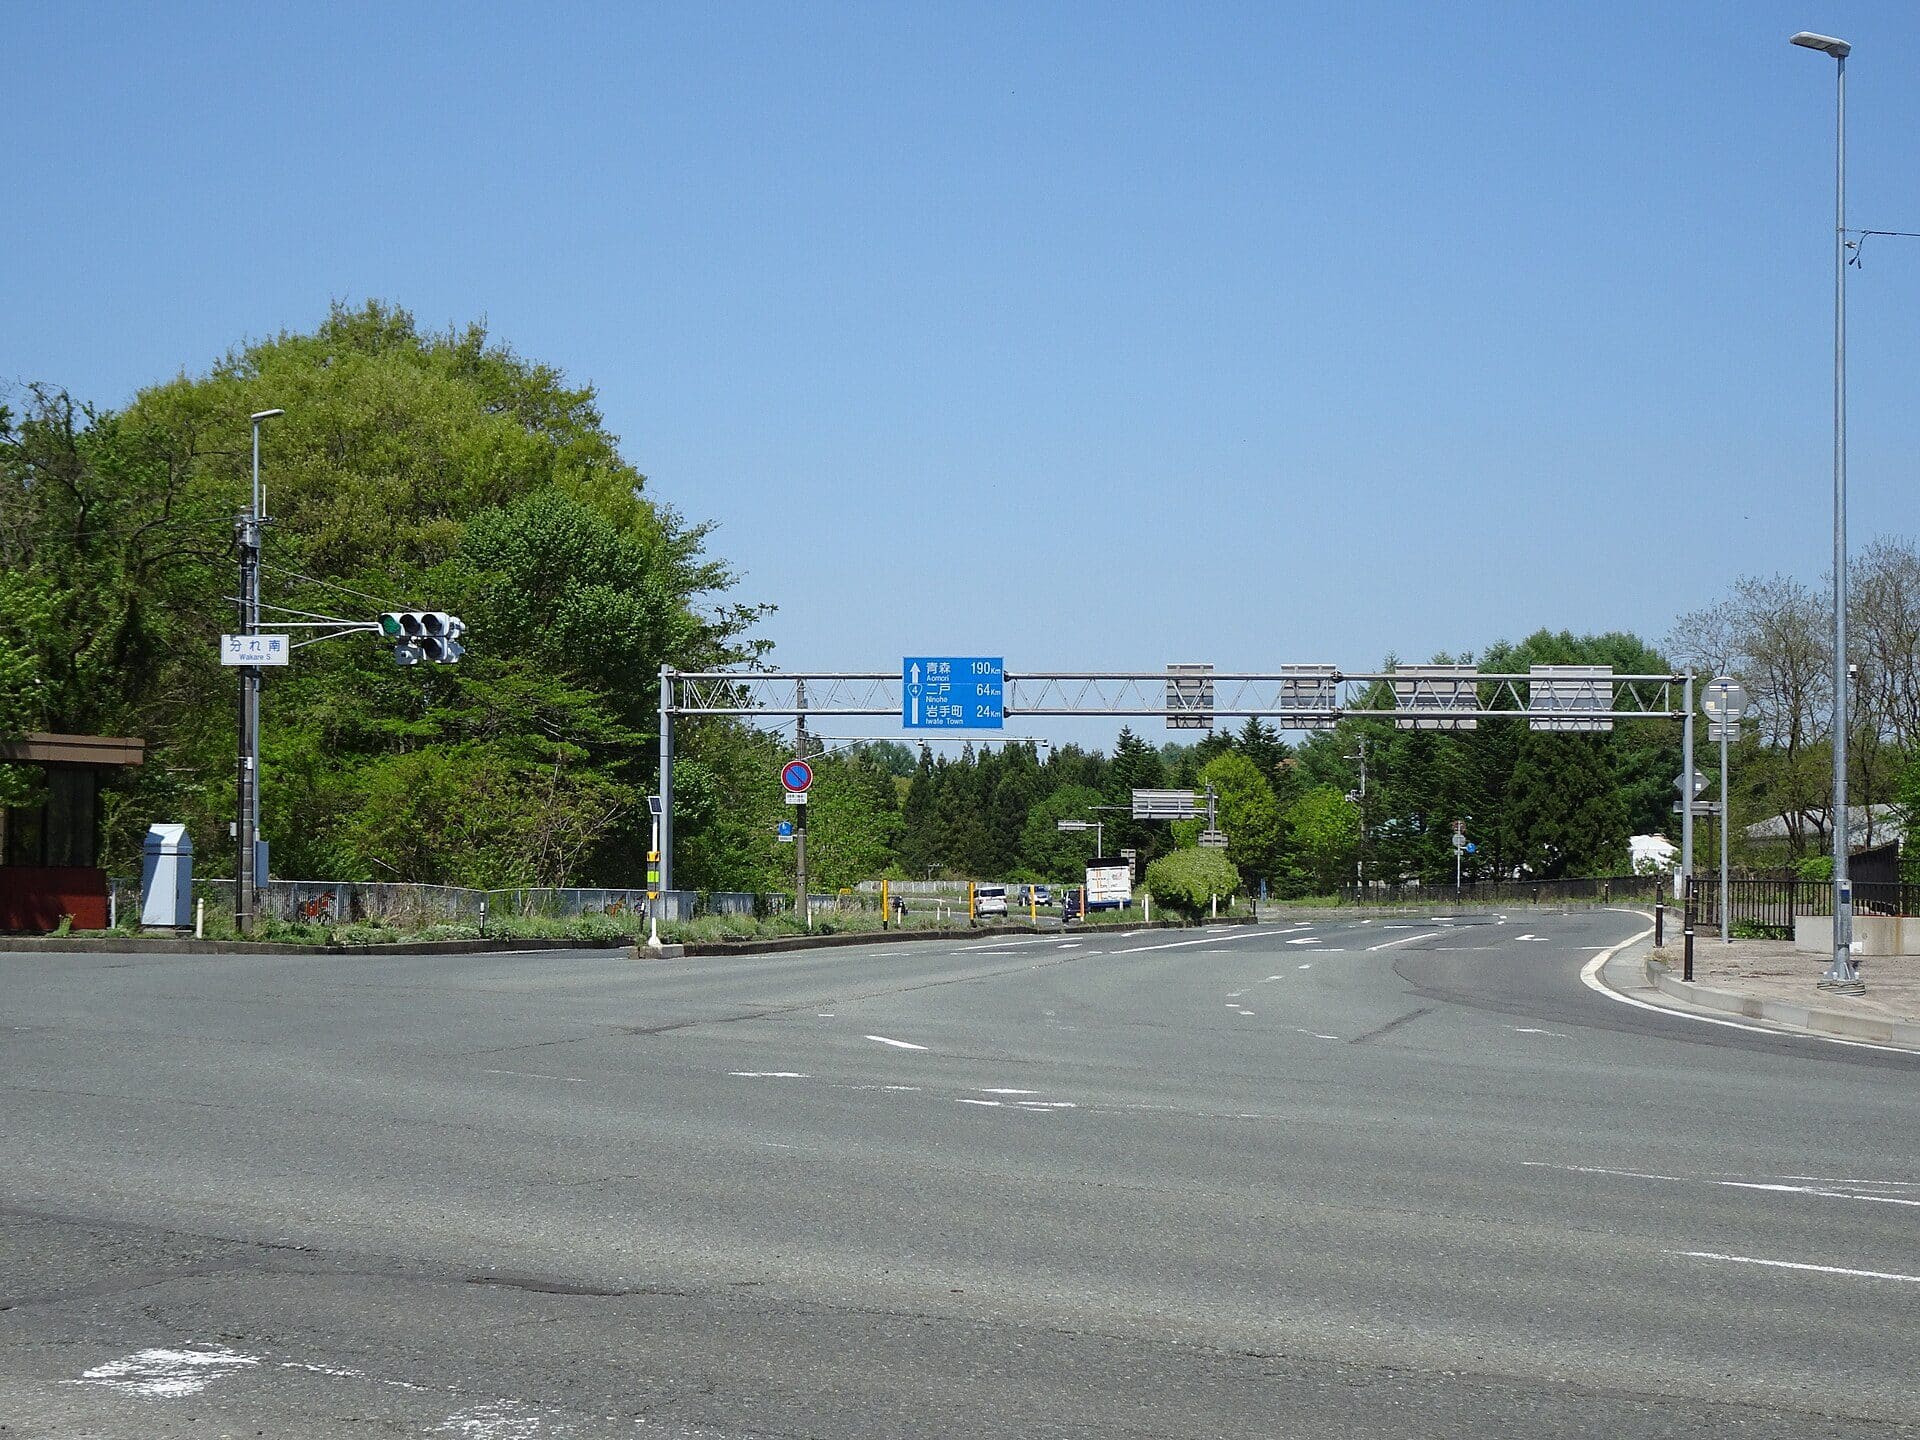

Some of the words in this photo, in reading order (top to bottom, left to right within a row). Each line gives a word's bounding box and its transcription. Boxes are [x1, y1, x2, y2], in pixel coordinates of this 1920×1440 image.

[926, 662, 951, 674] 青森
[912, 686, 918, 694] 4
[926, 683, 951, 695] 二戸
[926, 705, 963, 718] 岩手町
